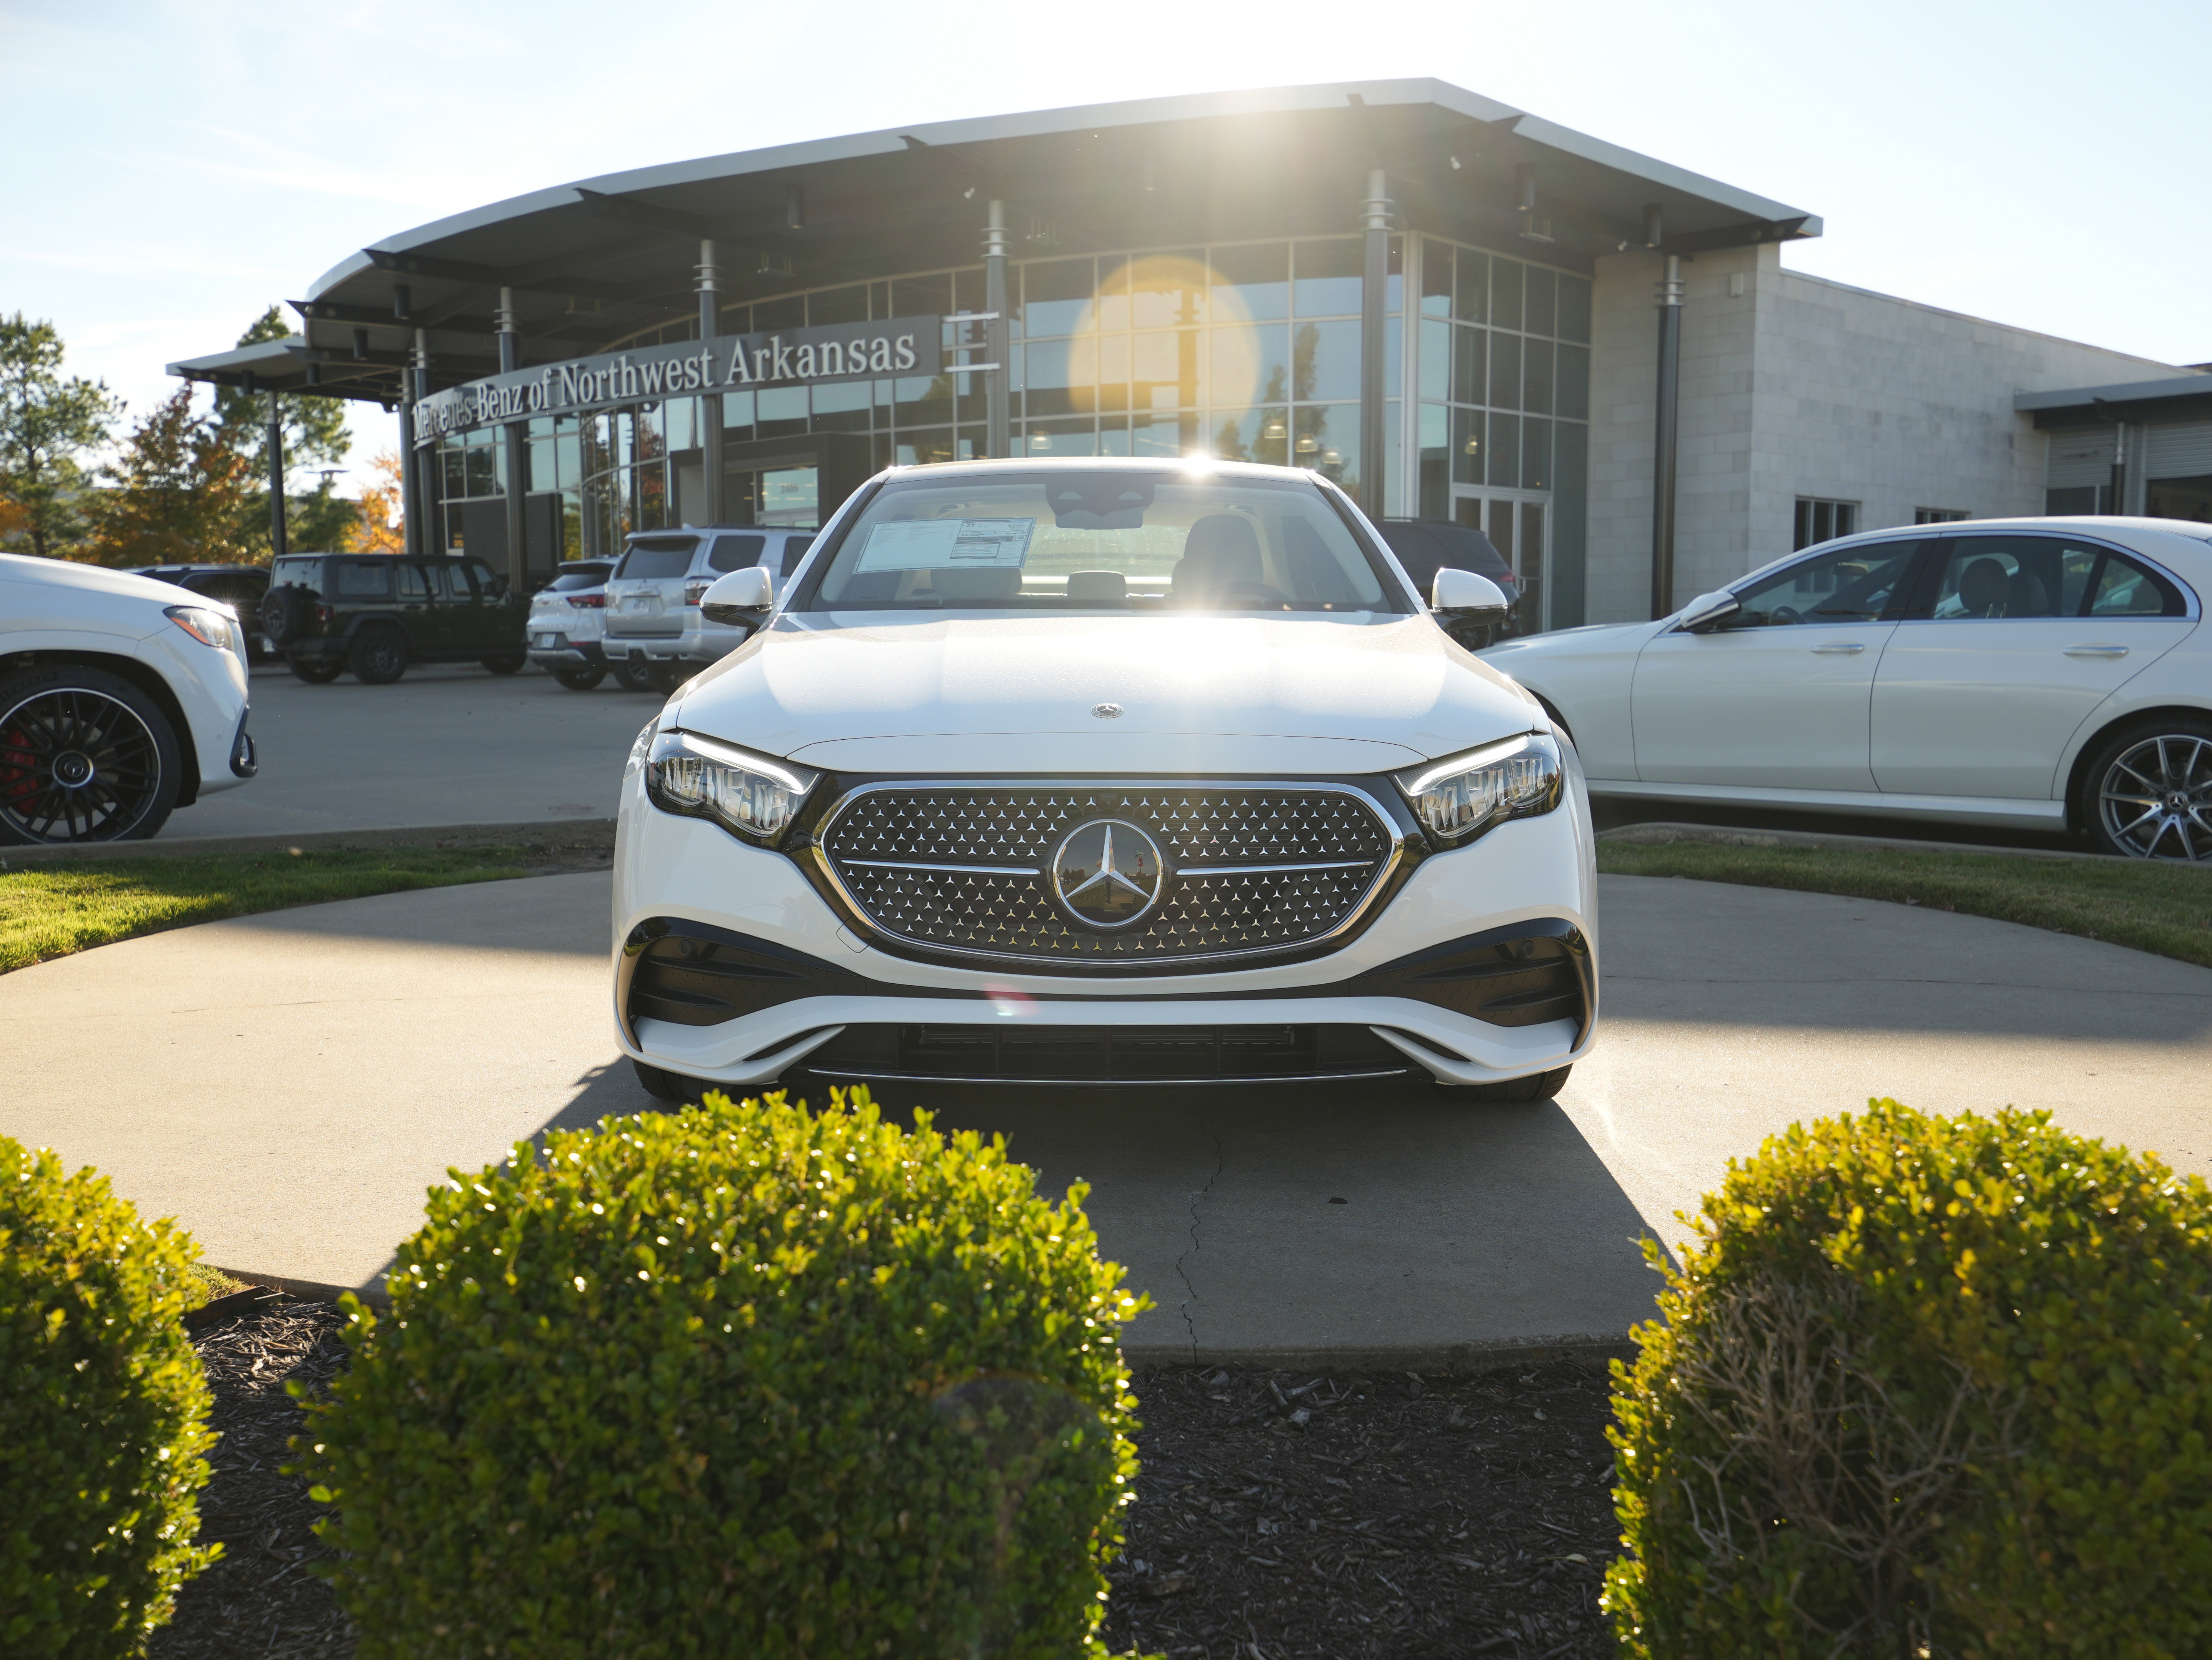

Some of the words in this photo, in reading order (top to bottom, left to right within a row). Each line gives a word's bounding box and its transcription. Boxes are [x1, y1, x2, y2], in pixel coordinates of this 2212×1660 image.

[411, 381, 523, 442] Mercedes-Benz
[528, 367, 552, 411] of
[558, 347, 713, 407] Northwest
[724, 333, 916, 385] Arkansas
